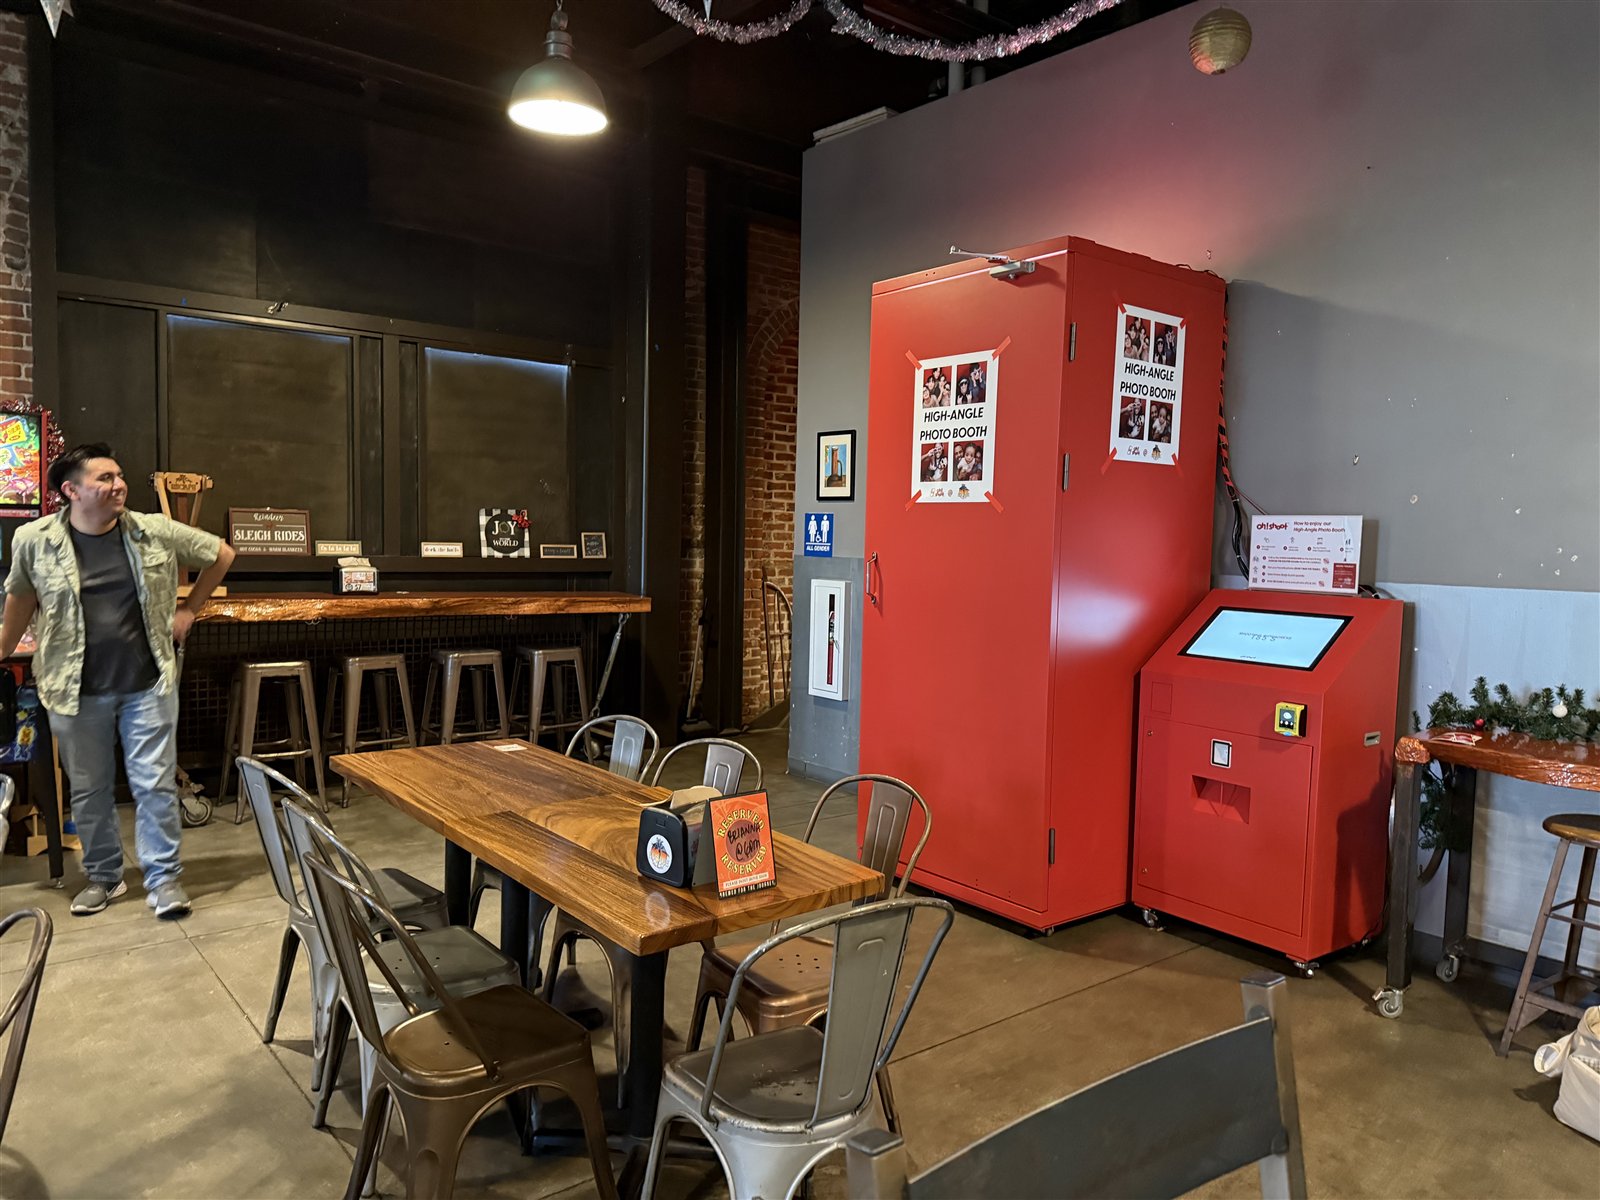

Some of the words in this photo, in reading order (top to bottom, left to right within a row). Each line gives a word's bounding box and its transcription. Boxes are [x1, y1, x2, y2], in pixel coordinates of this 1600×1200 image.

[1124, 362, 1174, 382] HIGH-ANGLE
[1119, 381, 1149, 396] PHOTO
[1149, 386, 1177, 401] BOOTH
[924, 407, 984, 422] HIGH-ANGLE
[920, 428, 951, 441] PHOTO
[952, 426, 988, 439] BOOTH
[234, 530, 271, 541] SLEIGH
[274, 530, 305, 541] RIDES
[717, 809, 765, 838] RESERVED
[727, 822, 761, 844] BRIANNA
[721, 845, 767, 875] RESERVED
